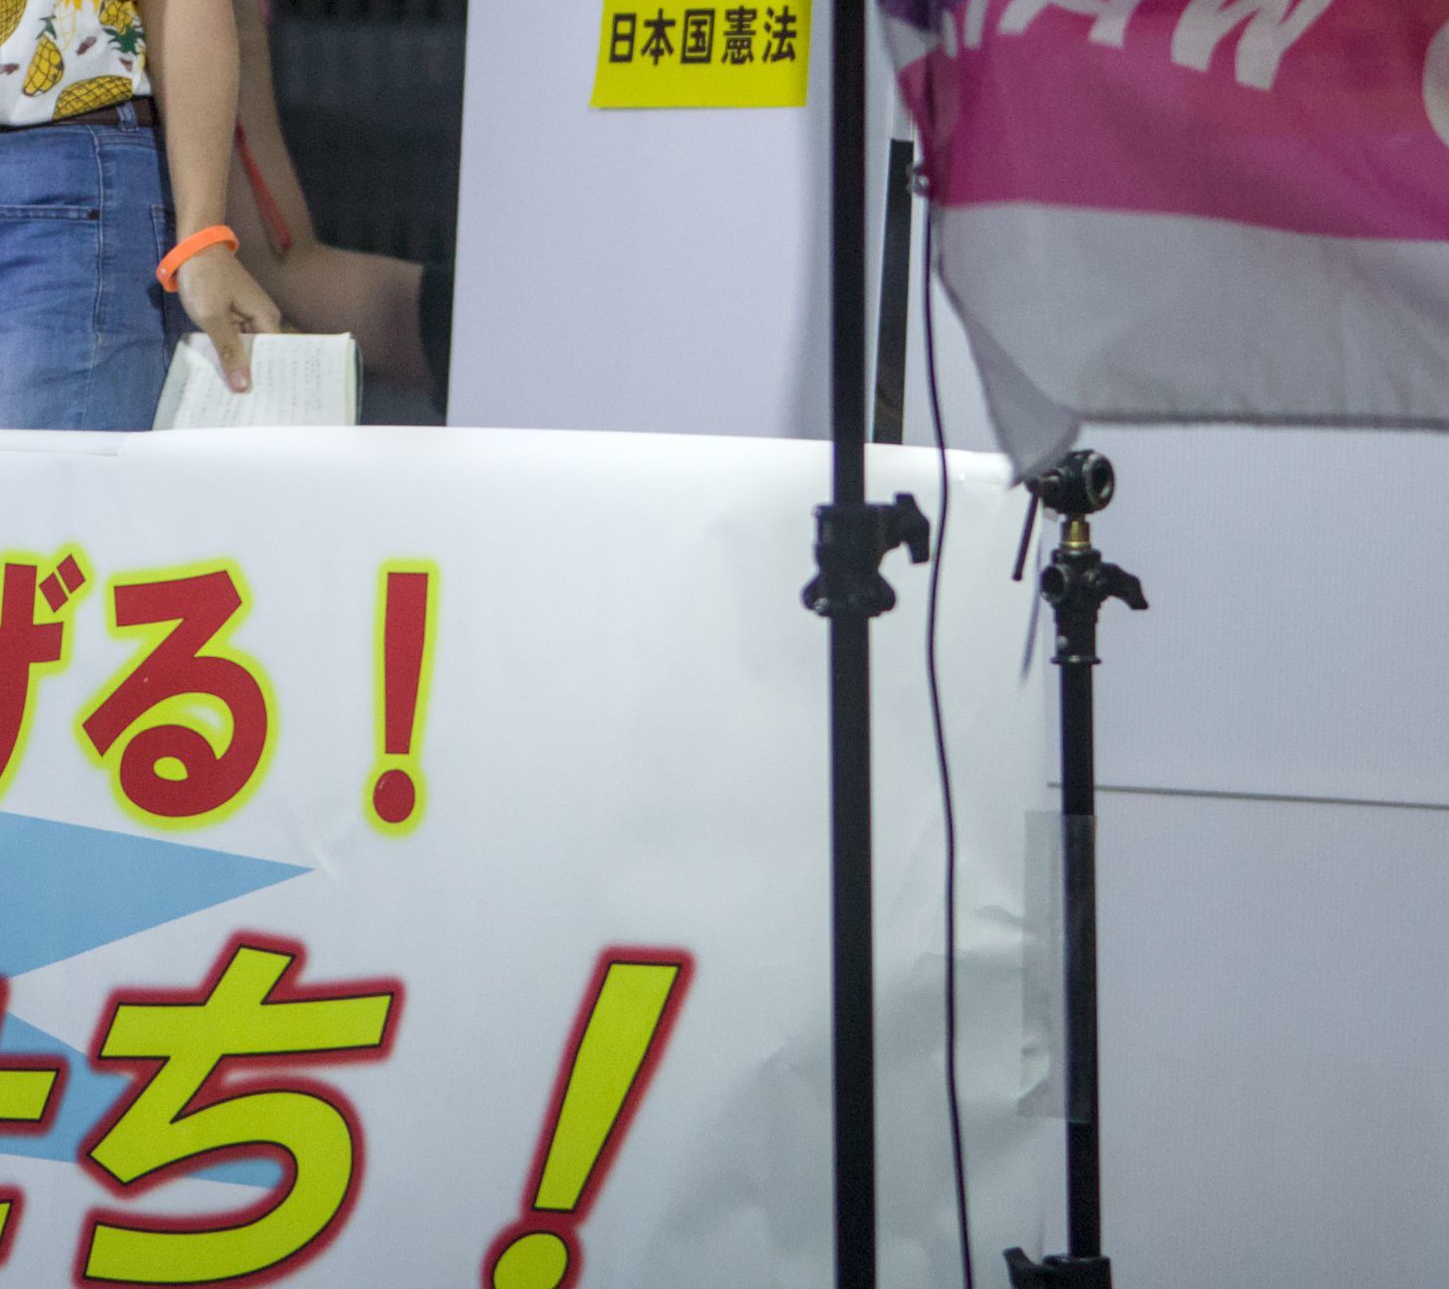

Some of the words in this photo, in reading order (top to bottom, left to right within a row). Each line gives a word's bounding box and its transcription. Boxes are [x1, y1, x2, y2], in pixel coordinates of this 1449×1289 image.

[608, 5, 797, 66] 日本国憲法
